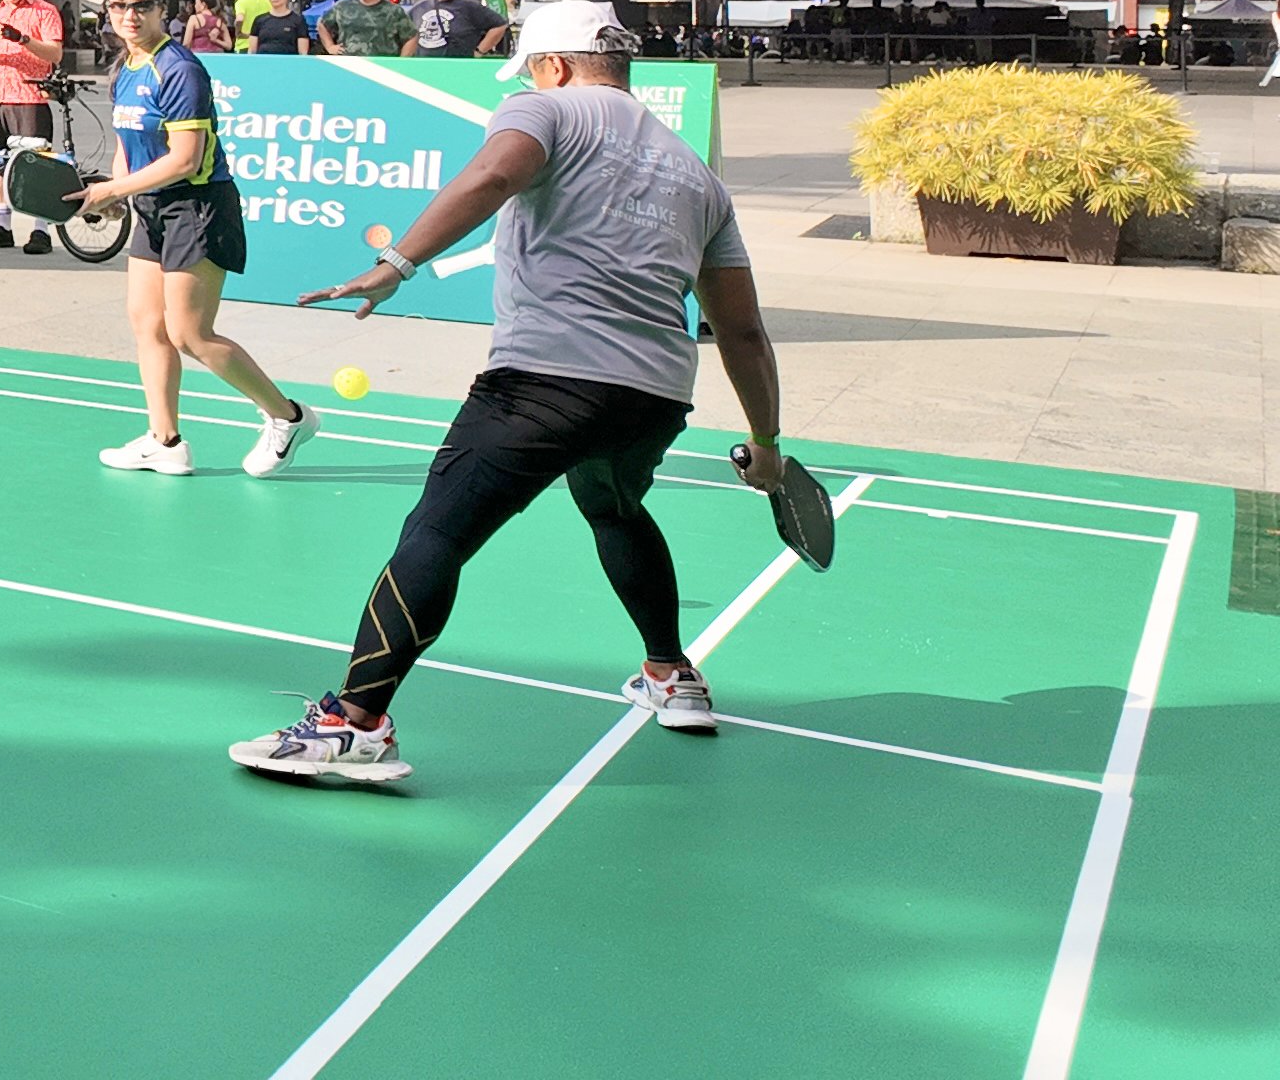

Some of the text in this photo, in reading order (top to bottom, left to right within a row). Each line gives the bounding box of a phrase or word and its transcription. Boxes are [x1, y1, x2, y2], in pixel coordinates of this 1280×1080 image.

[212, 80, 241, 99] he
[669, 86, 687, 103] IT
[226, 141, 442, 191] ickleball
[240, 186, 346, 229] ries
[625, 195, 678, 226] BLAKE
